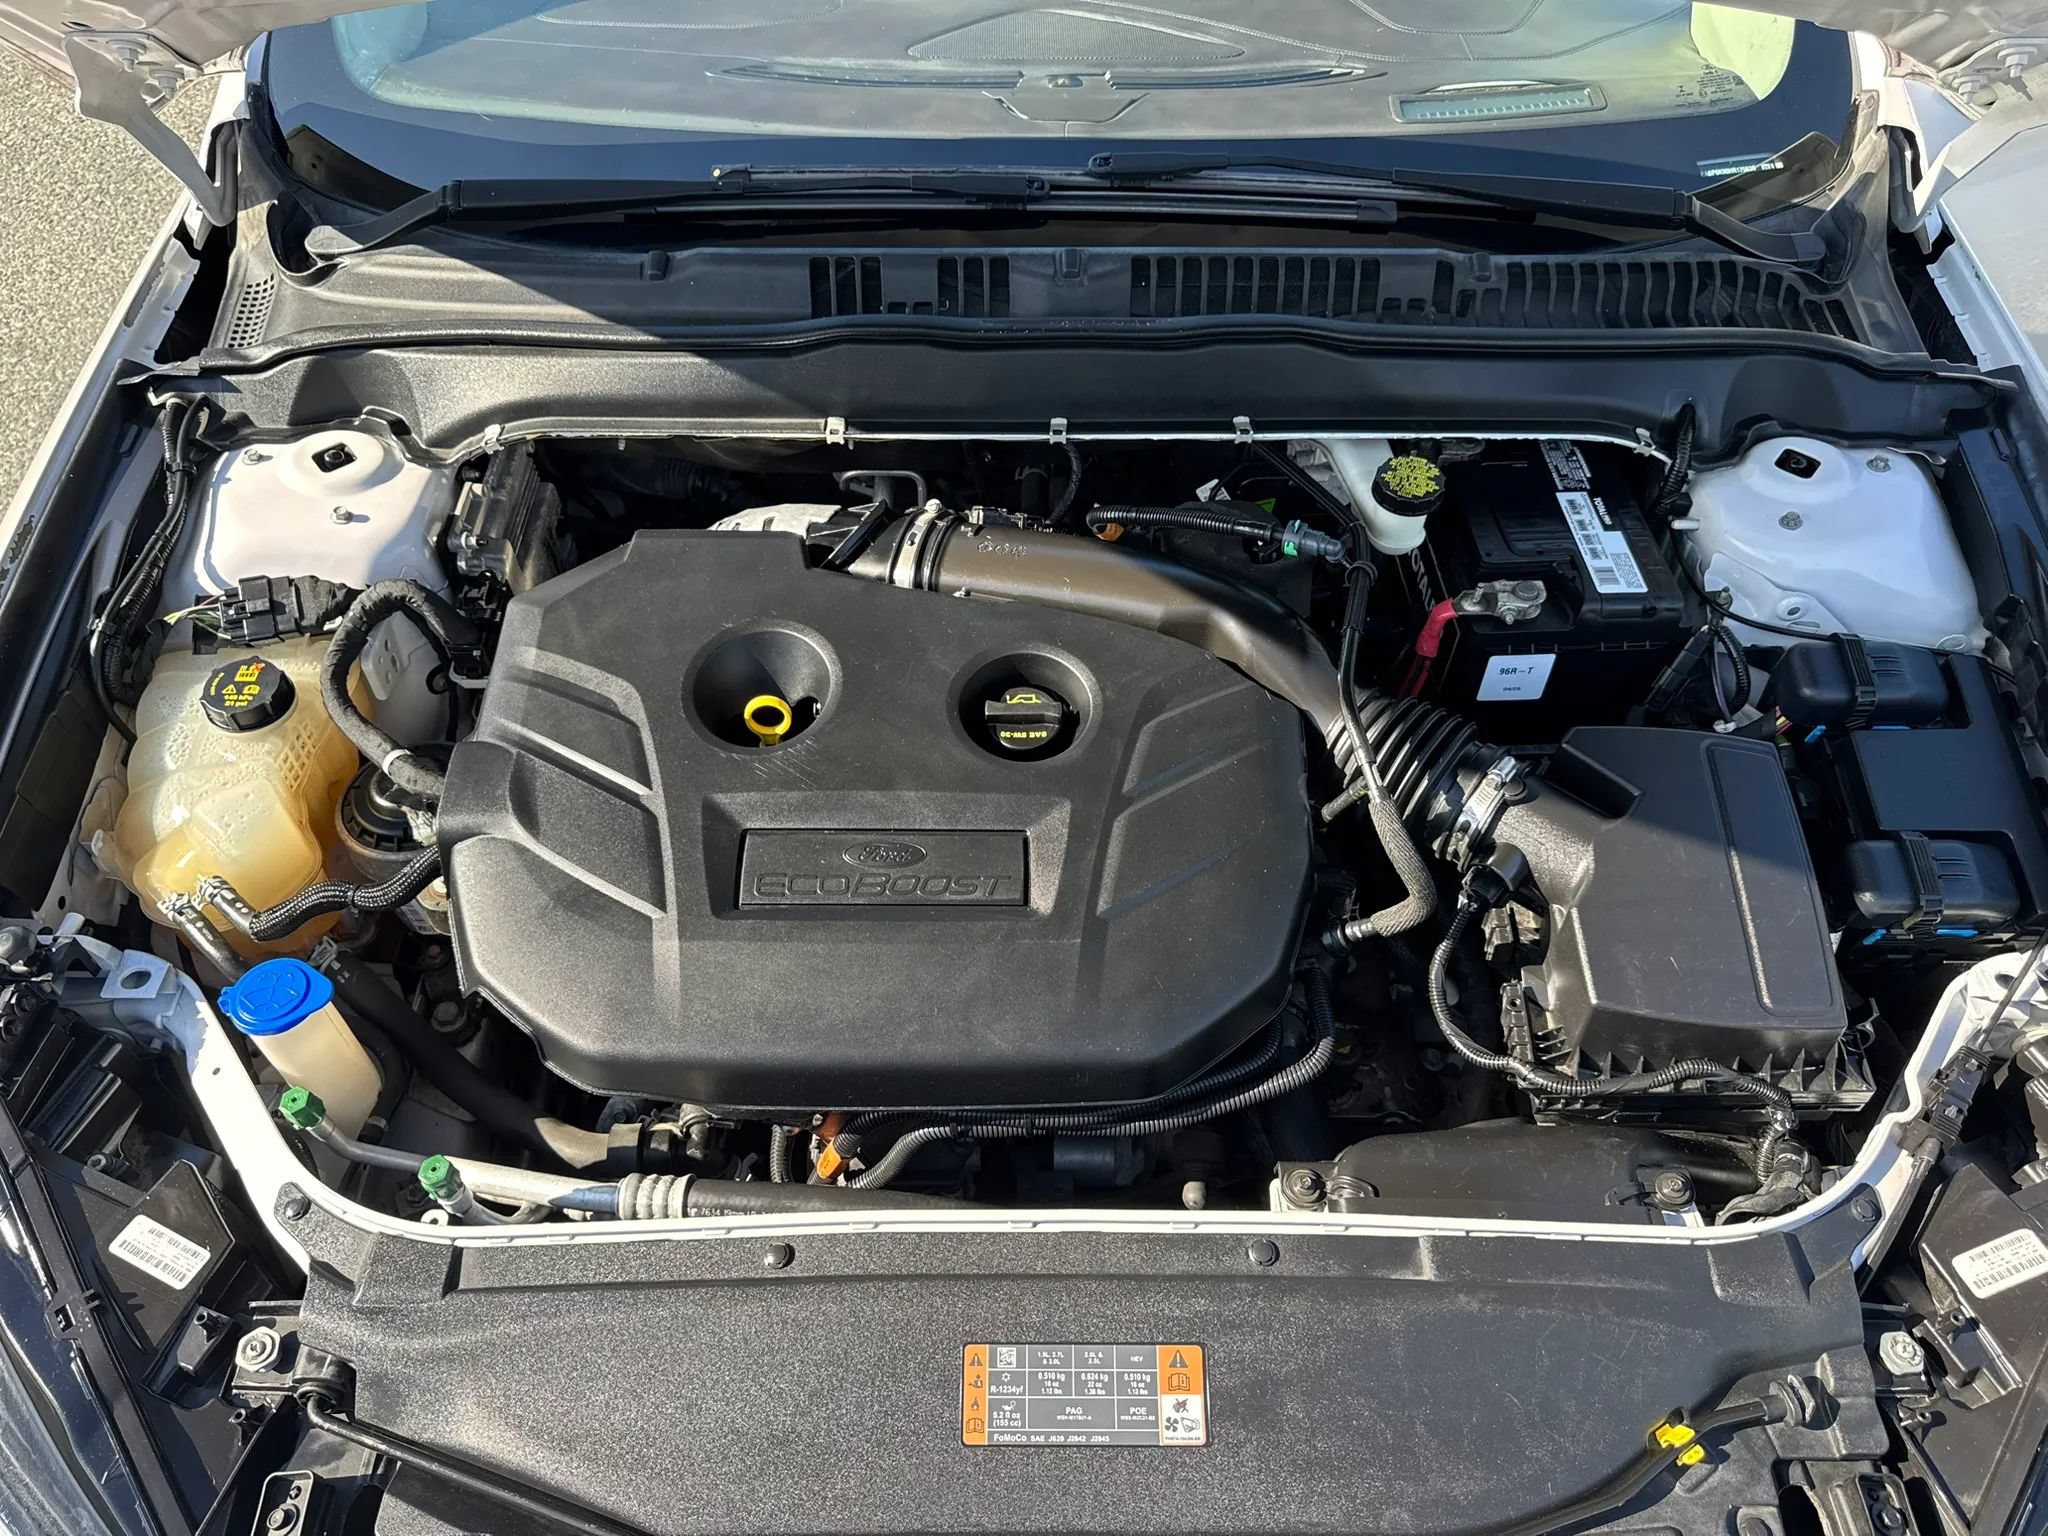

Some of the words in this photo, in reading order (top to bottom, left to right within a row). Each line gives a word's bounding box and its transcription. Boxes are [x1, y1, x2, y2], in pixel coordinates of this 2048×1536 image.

[1029, 731, 1048, 739] SAE
[858, 843, 912, 862] Ford
[1038, 1372, 1055, 1380] 0.510
[1057, 1372, 1065, 1382] kg
[1100, 1373, 1108, 1382] kg
[1142, 1373, 1150, 1382] kg
[990, 1385, 1023, 1395] R-1234yf
[993, 1411, 1004, 1419] 5.2
[1065, 1407, 1082, 1415] PAG
[1129, 1407, 1147, 1415] POE
[993, 1419, 1008, 1427] (155
[1010, 1419, 1021, 1427] cc)
[993, 1434, 1027, 1442] FoMoCo
